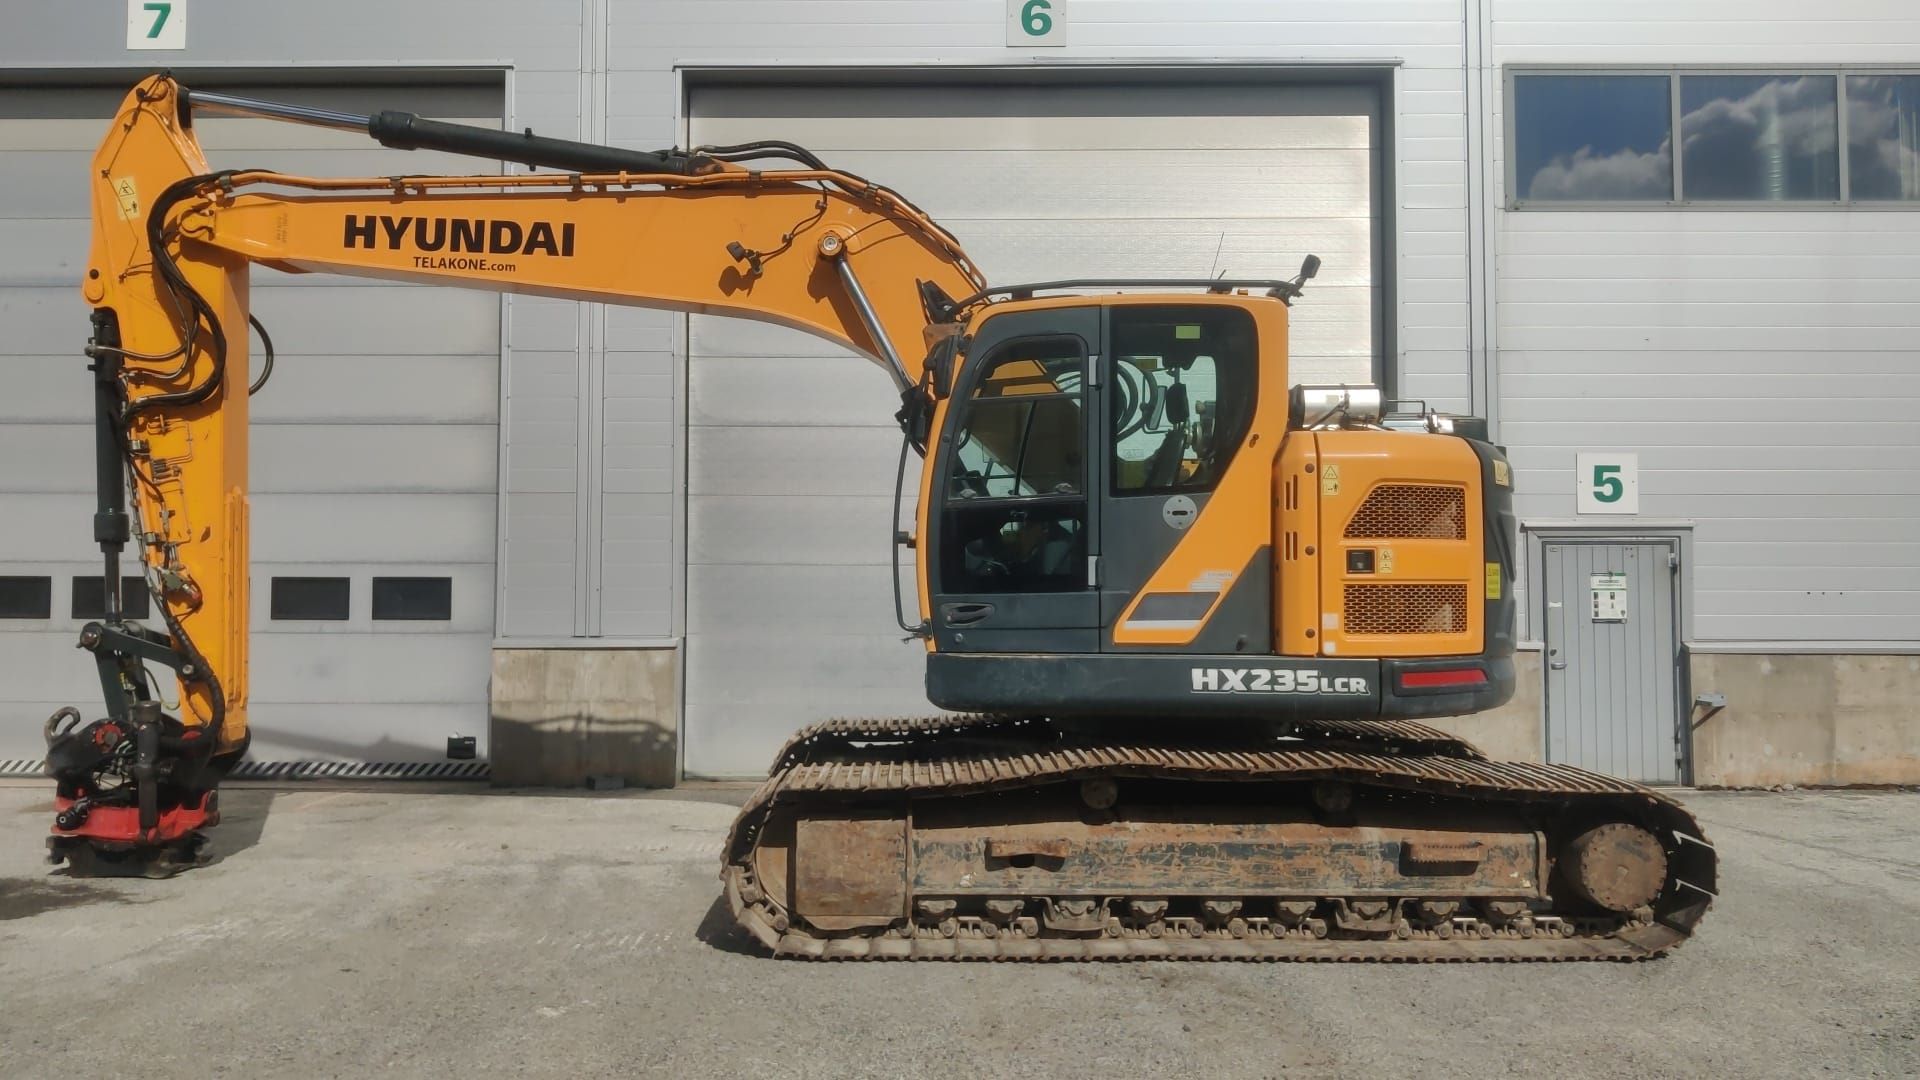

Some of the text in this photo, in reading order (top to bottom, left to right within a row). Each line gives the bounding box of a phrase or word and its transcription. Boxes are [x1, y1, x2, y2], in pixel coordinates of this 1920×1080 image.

[143, 2, 171, 39] 7
[1021, 0, 1052, 36] 6
[343, 214, 576, 257] HYUNDAI
[413, 256, 516, 272] TELAKONE.com
[1593, 464, 1623, 503] 5
[1191, 668, 1367, 693] HX235LCR
